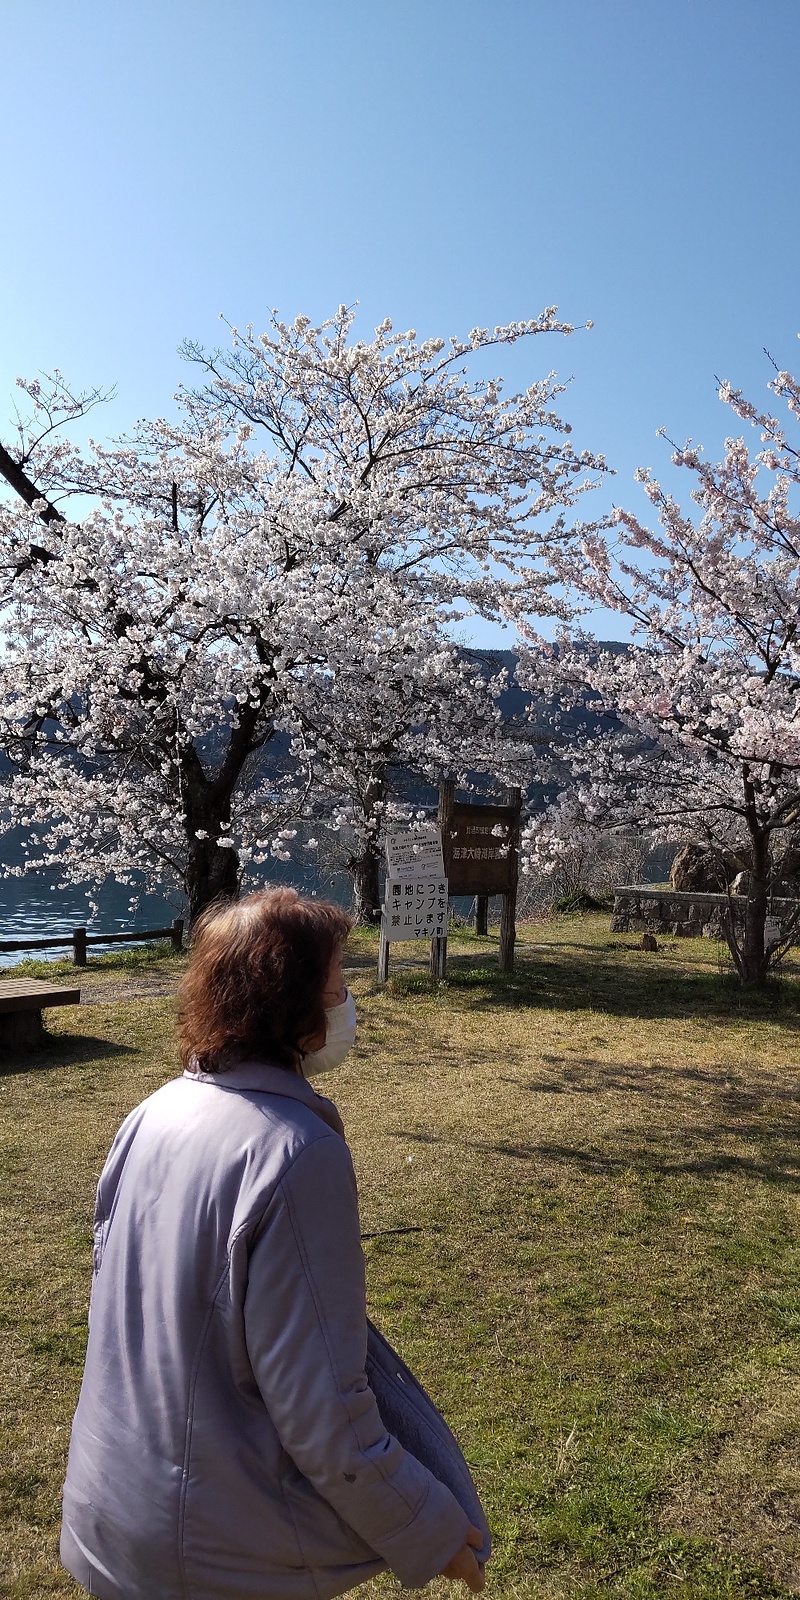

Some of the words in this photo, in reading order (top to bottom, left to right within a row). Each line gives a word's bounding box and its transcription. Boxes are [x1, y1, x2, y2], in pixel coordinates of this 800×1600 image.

[392, 883, 446, 896] 園地につき
[392, 897, 446, 910] キャンプを
[391, 912, 446, 926] 禁止します
[414, 927, 444, 937] マキノ町
